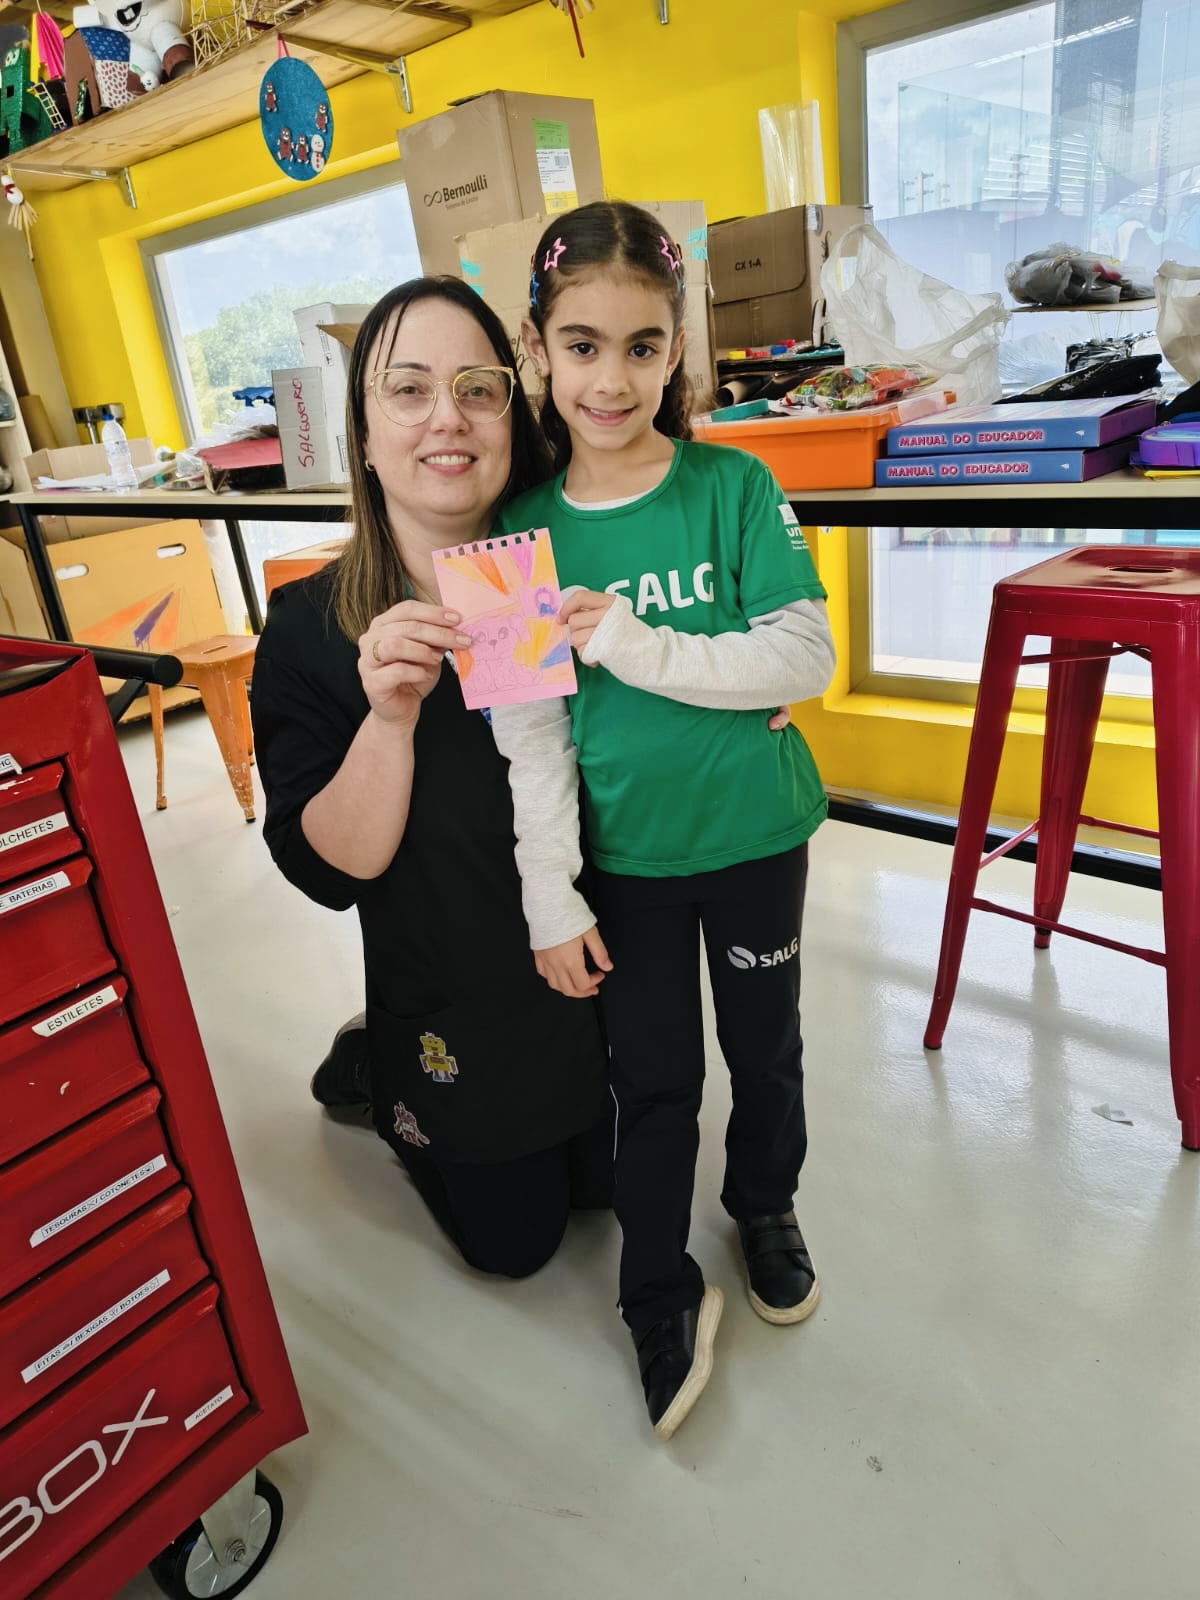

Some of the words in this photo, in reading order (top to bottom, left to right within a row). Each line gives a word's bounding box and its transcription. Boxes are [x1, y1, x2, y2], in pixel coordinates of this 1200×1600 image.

[442, 174, 488, 202] Bernoulli
[735, 260, 746, 271] CX
[748, 258, 762, 269] 1-A
[899, 434, 947, 447] MANUAL
[953, 433, 971, 444] DO
[978, 430, 1043, 443] EDUCADOR
[887, 466, 935, 477] MANUAL
[940, 466, 958, 476] DO
[965, 463, 1029, 474] EDUCADOR
[0, 820, 54, 848] LCHETES
[9, 880, 54, 903] BATERIAS
[759, 937, 799, 968] SALG
[47, 995, 104, 1031] ESTILETES
[44, 1205, 88, 1235] TESOURAS
[99, 1168, 146, 1201] COTONETES
[37, 1349, 61, 1369] FITAS
